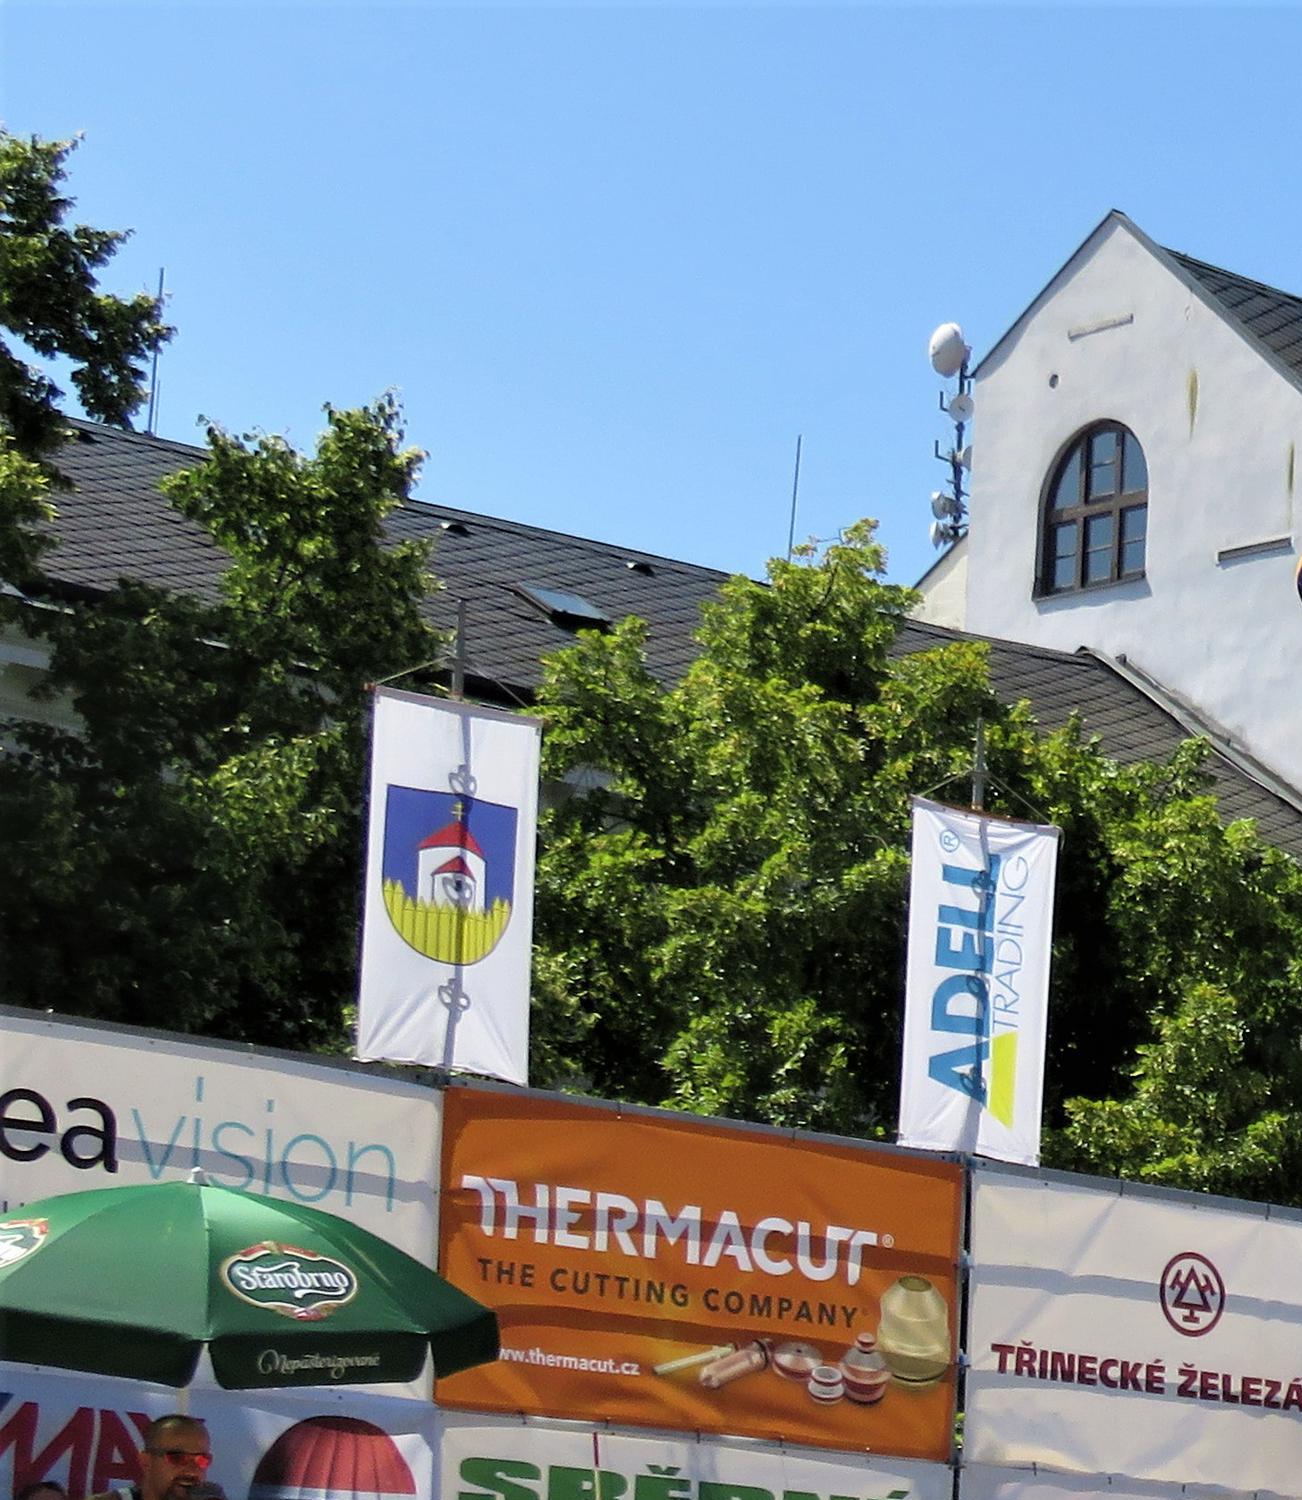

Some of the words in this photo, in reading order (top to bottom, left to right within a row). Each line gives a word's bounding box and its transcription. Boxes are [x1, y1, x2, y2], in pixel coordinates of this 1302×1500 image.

[991, 855, 1028, 1034] TRADING
[928, 854, 1001, 1109] ADELL
[461, 1174, 877, 1287] THERMACUT
[238, 1260, 349, 1298] Starobrno
[477, 1257, 534, 1287] THE
[549, 1270, 689, 1308] CUTTING
[703, 1287, 859, 1329] COMPANY
[499, 1346, 640, 1376] ww.thermacut.cz
[991, 1340, 1165, 1395] TŘINECKÉ
